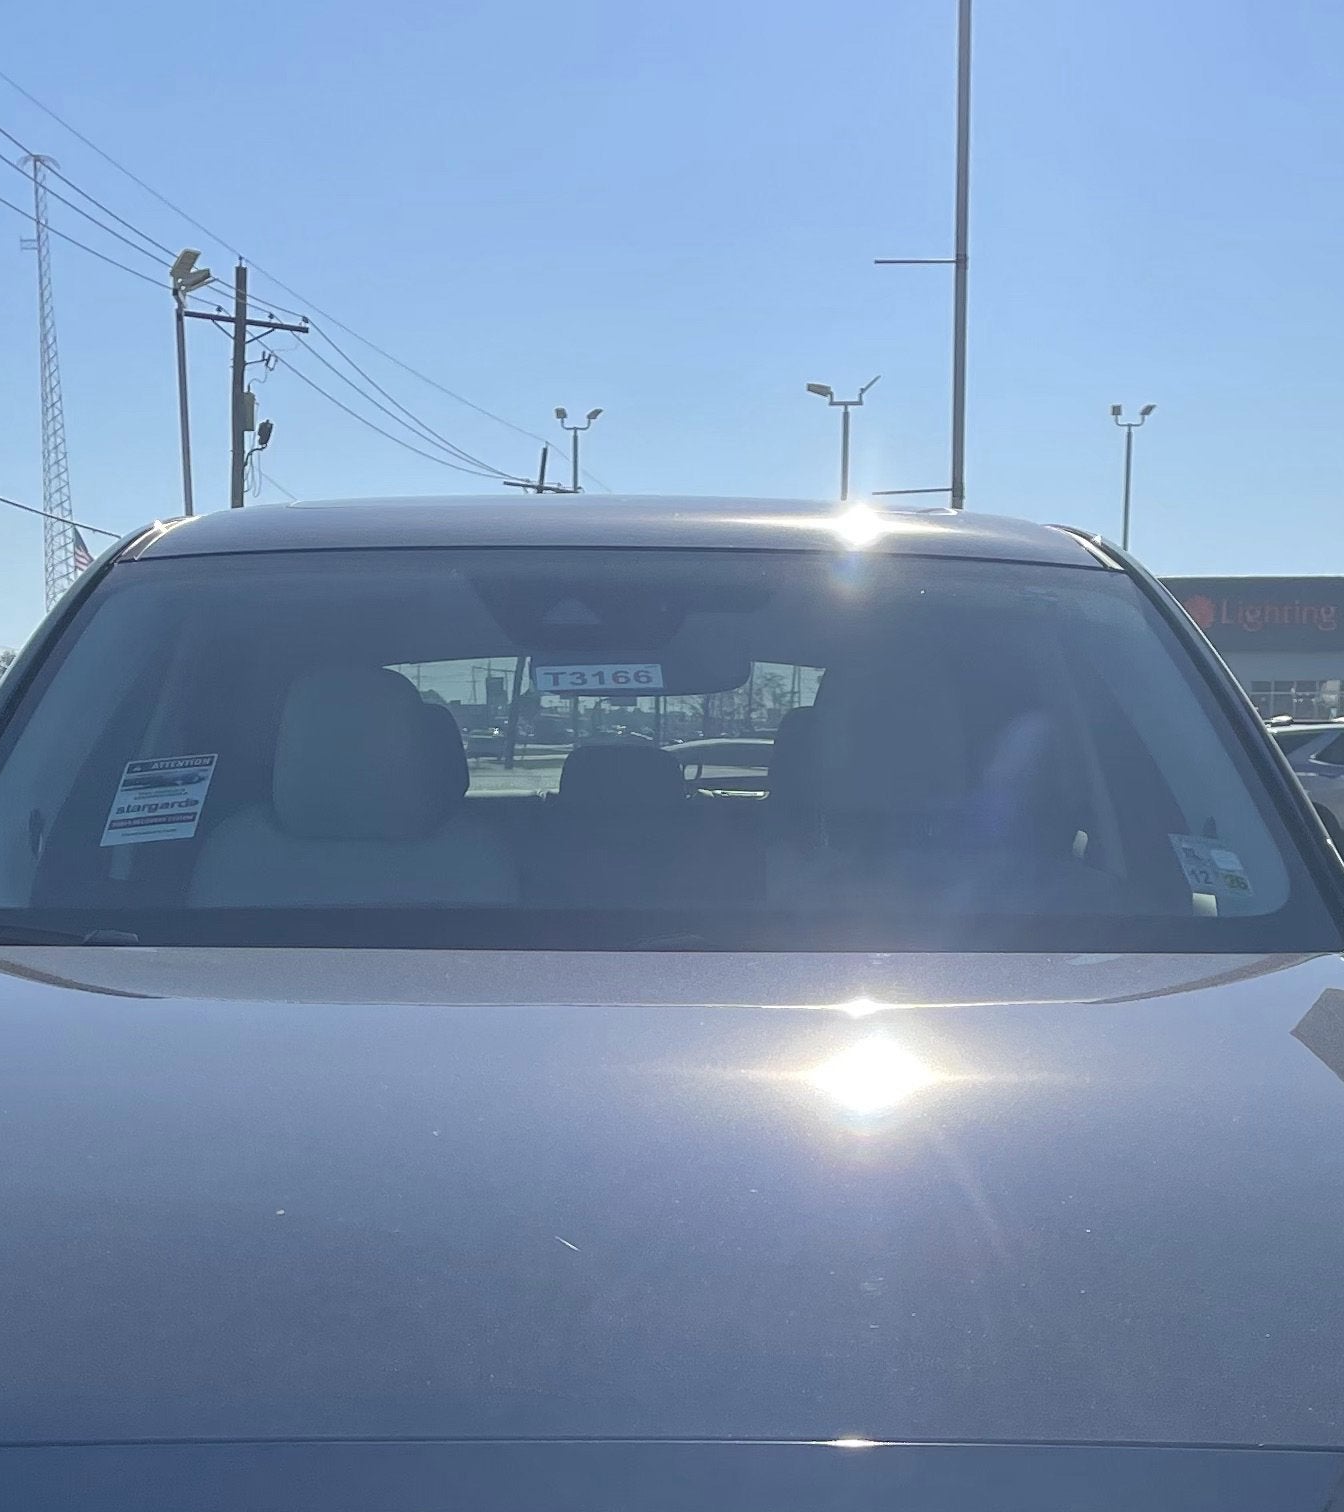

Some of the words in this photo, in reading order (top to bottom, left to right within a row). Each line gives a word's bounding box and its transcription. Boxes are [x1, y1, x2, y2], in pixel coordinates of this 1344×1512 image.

[1220, 599, 1338, 632] Lighting
[543, 669, 654, 687] T3166
[151, 757, 211, 770] ATTENTION
